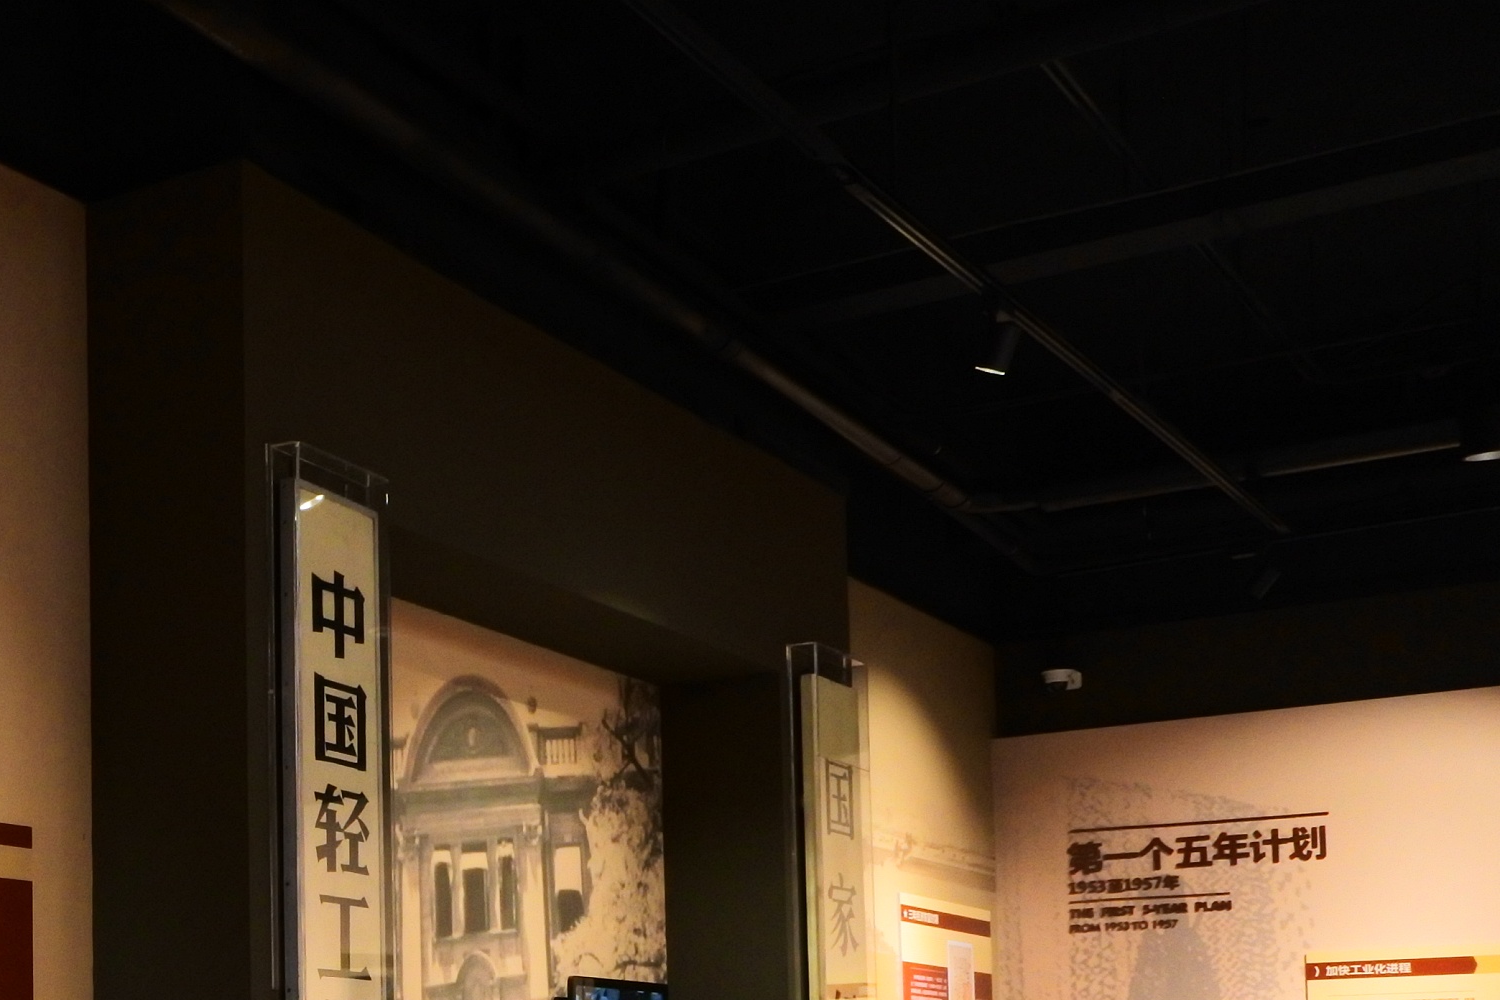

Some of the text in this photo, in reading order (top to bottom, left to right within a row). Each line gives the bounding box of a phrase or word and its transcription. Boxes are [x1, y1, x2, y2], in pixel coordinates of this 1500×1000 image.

[1067, 825, 1327, 876] 第一个五年计划
[1132, 920, 1148, 930] TO
[1325, 962, 1412, 976] 加快工业化进程
